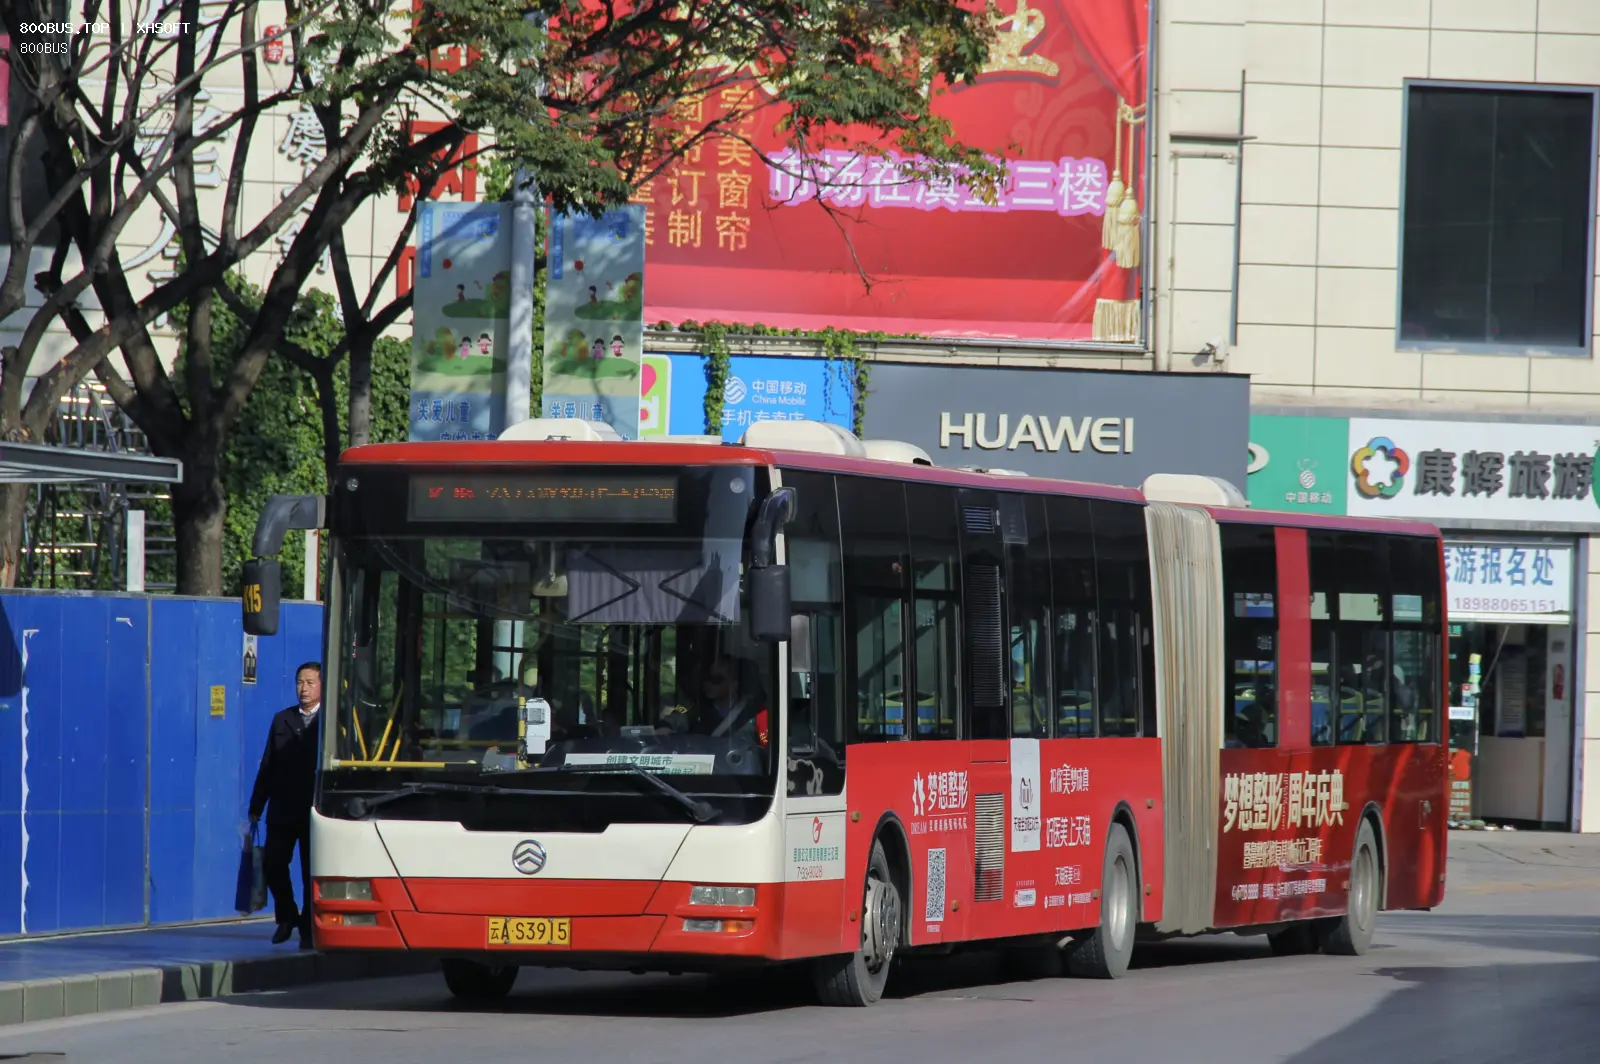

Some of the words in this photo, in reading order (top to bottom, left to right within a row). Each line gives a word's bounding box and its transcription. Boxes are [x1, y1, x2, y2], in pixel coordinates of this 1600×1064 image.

[715, 84, 753, 252] 完美窗帘
[751, 379, 807, 396] 中国移动
[418, 400, 472, 423] 关爱儿童
[751, 394, 778, 405] China
[778, 396, 807, 406] Mobile
[940, 412, 1134, 454] HUAWEI
[1413, 448, 1595, 500] 康辉旅游
[1285, 491, 1332, 504] 中国移动
[1455, 597, 1557, 612] 18988065151
[606, 755, 673, 766] 创建文明城市
[927, 769, 968, 811] 梦想整形
[1223, 771, 1284, 833] 梦想整形
[1287, 768, 1344, 829] 周年庆典
